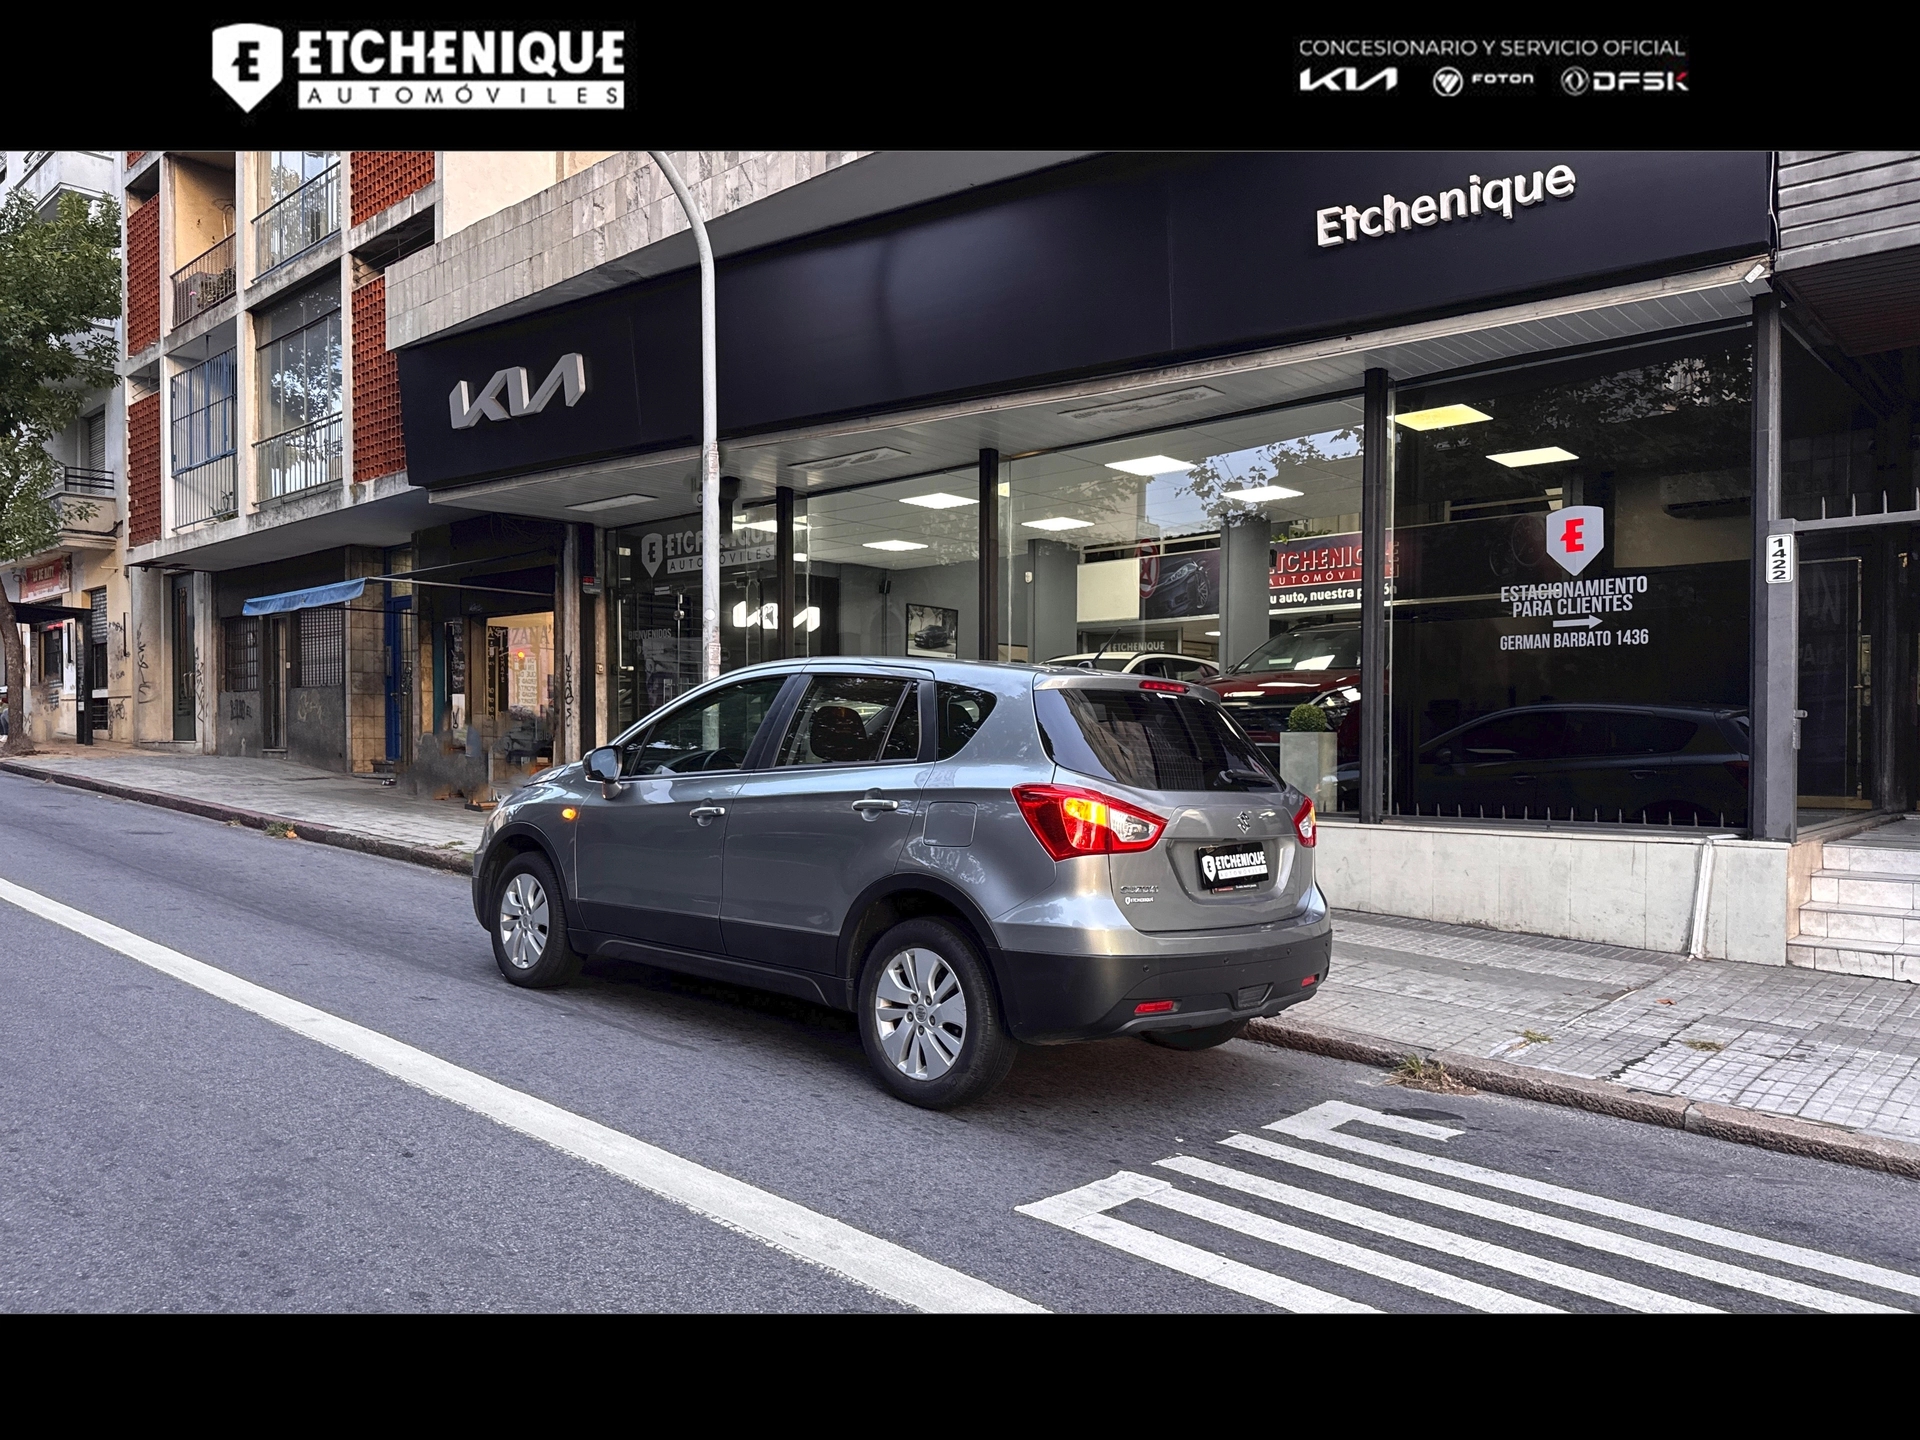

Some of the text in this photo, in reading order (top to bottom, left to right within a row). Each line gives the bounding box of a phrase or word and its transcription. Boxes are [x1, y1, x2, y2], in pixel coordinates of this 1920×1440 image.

[1316, 164, 1576, 248] Etchenique
[449, 352, 586, 430] KIA
[1772, 538, 1787, 580] 1422
[1310, 588, 1355, 601] nuestra
[1500, 575, 1648, 602] ESTACIONAMIENTO
[1512, 594, 1633, 618] PARA CLIENTES
[628, 628, 672, 641] BIENVENIDOS
[1500, 628, 1649, 651] GERMAN BARBATO 1436
[1112, 641, 1165, 652] ETCHENIQUE
[1215, 851, 1266, 870] ETCHENIQUE
